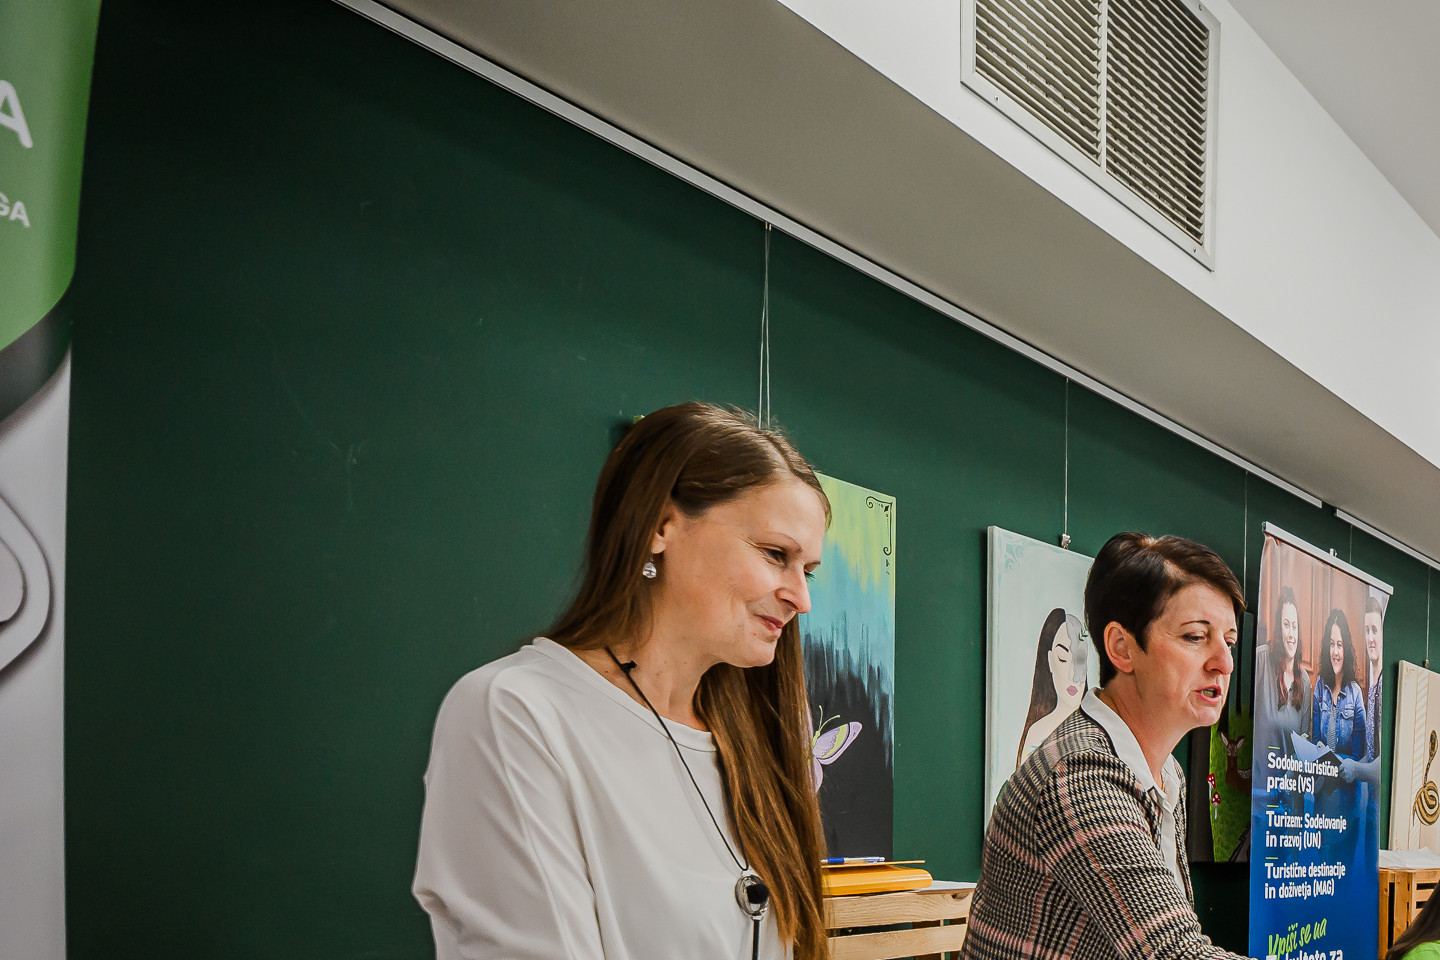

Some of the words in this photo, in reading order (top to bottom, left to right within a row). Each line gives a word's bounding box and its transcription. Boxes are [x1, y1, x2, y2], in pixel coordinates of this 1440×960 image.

[1267, 752, 1303, 772] Sodobne
[1304, 760, 1339, 777] turistične
[1266, 776, 1297, 793] prakse
[1298, 776, 1315, 794] (VS)
[1265, 810, 1303, 828] Turizem:
[1304, 813, 1347, 833] Sodelovanje
[1265, 831, 1277, 847] in
[1279, 833, 1302, 851] razvoj
[1303, 832, 1322, 849] (UN)
[1265, 862, 1307, 879] Turistične
[1308, 861, 1346, 879] destinacije
[1264, 883, 1276, 899] in
[1278, 881, 1312, 900] doživetja
[1313, 878, 1335, 897] (MAG)
[1299, 923, 1312, 947] se
[1313, 917, 1327, 940] na
